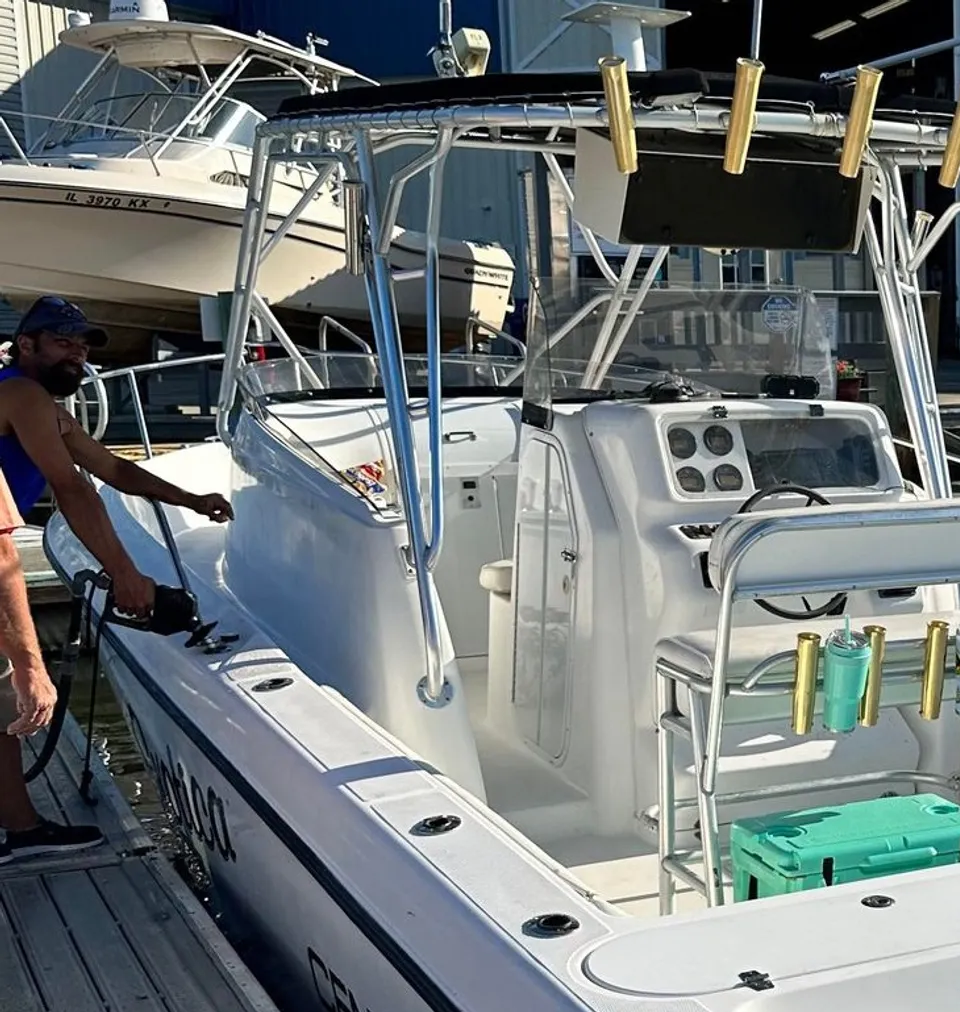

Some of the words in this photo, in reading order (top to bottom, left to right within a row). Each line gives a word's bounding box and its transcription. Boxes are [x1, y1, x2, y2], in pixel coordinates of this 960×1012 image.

[65, 192, 77, 202] IL
[87, 194, 121, 208] 3970
[128, 198, 150, 208] KX
